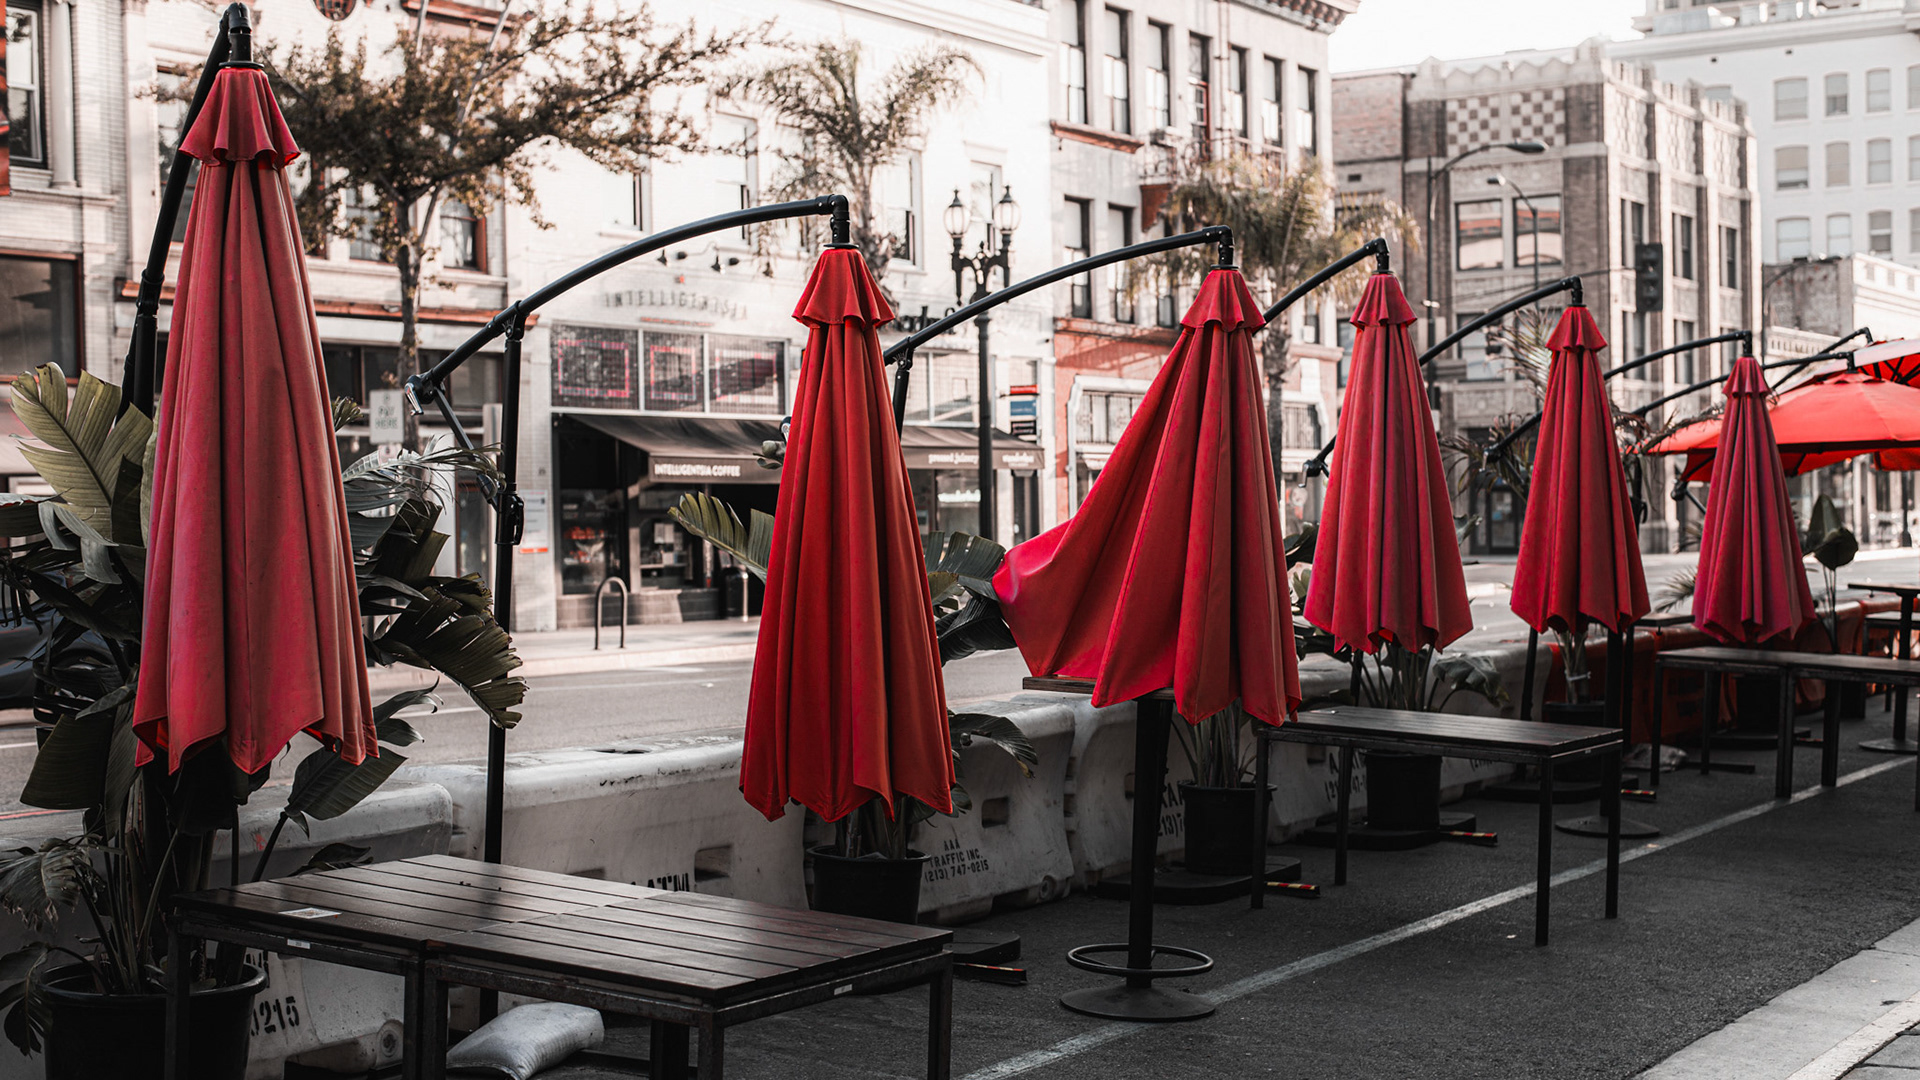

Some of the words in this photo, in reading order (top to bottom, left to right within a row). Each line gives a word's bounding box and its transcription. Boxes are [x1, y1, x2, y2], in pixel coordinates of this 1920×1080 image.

[654, 463, 712, 477] INTELLIGENTSIA
[712, 465, 741, 477] COFFEE
[943, 838, 961, 852] AAA
[929, 851, 965, 868] TRAFFIC
[966, 848, 983, 861] INC.
[924, 868, 950, 883] (213)
[950, 859, 989, 878] 747-0215
